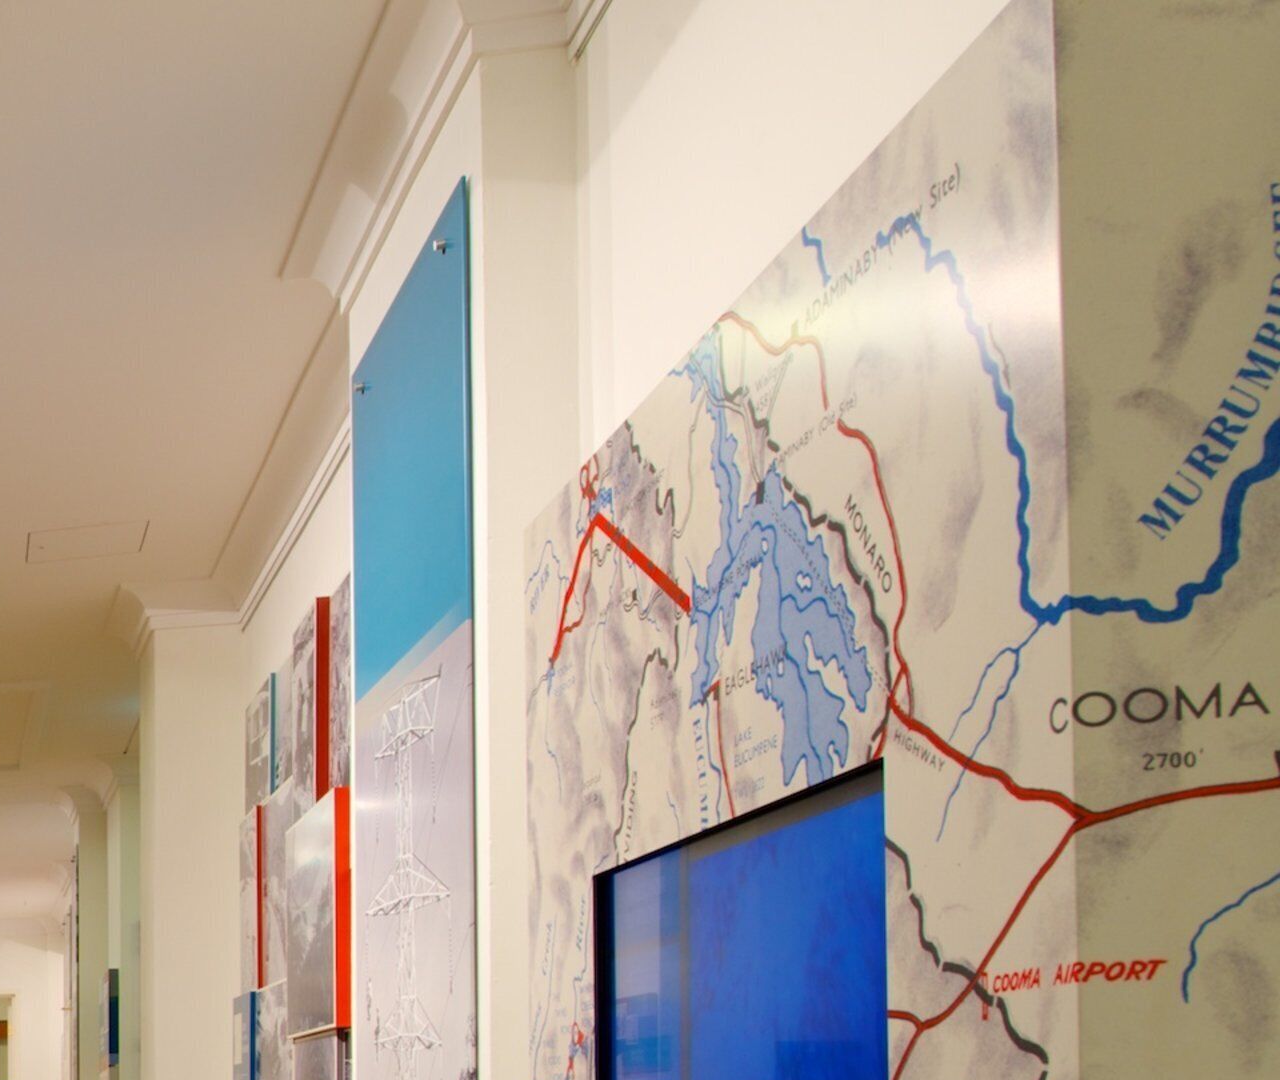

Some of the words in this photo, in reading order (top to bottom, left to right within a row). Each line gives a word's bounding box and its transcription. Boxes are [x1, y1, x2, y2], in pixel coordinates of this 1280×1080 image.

[928, 162, 962, 210] Site)
[843, 494, 893, 595] MONARO
[1049, 681, 1271, 735] COOMA
[893, 727, 946, 773] HIGHWAY
[992, 966, 1042, 993] COOMA
[1052, 958, 1169, 986] AIRPORT
